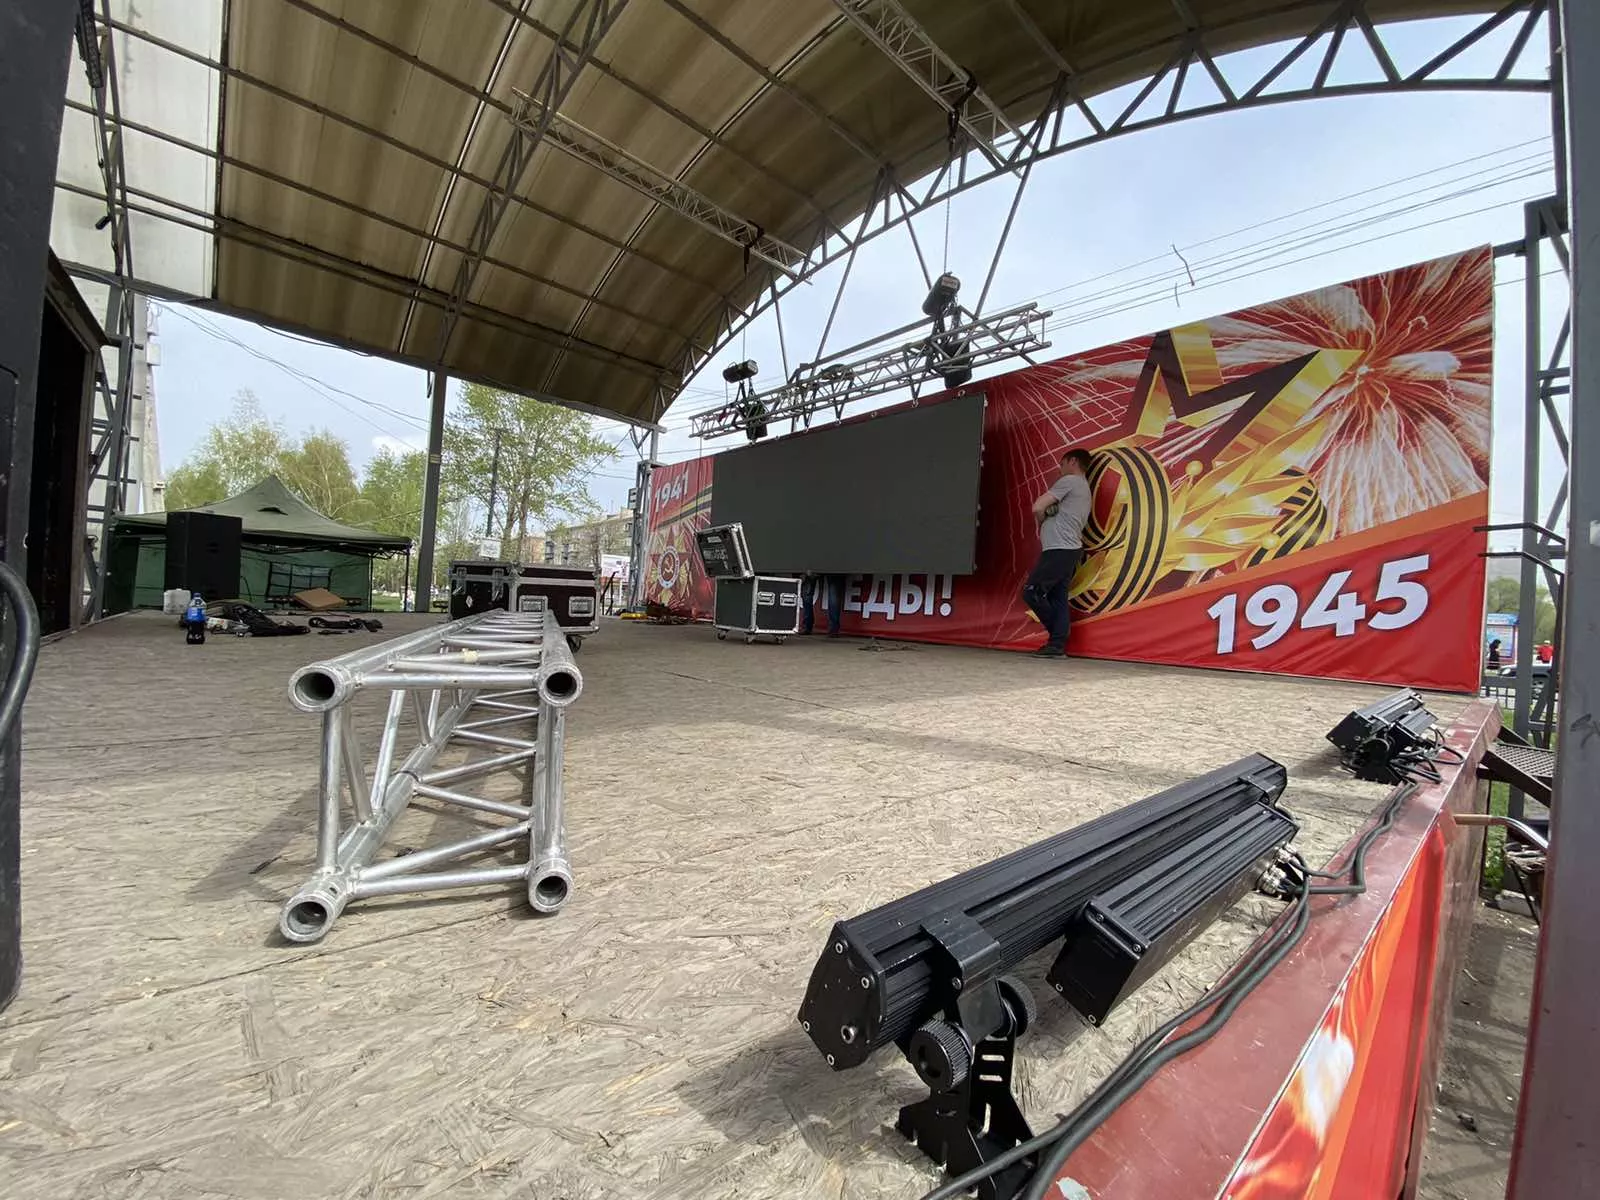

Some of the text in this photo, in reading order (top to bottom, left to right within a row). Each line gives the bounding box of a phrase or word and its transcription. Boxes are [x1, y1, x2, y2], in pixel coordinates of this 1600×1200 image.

[655, 470, 689, 512] 1941
[801, 574, 952, 620] ЕДЫ!
[1207, 554, 1429, 654] 1945
